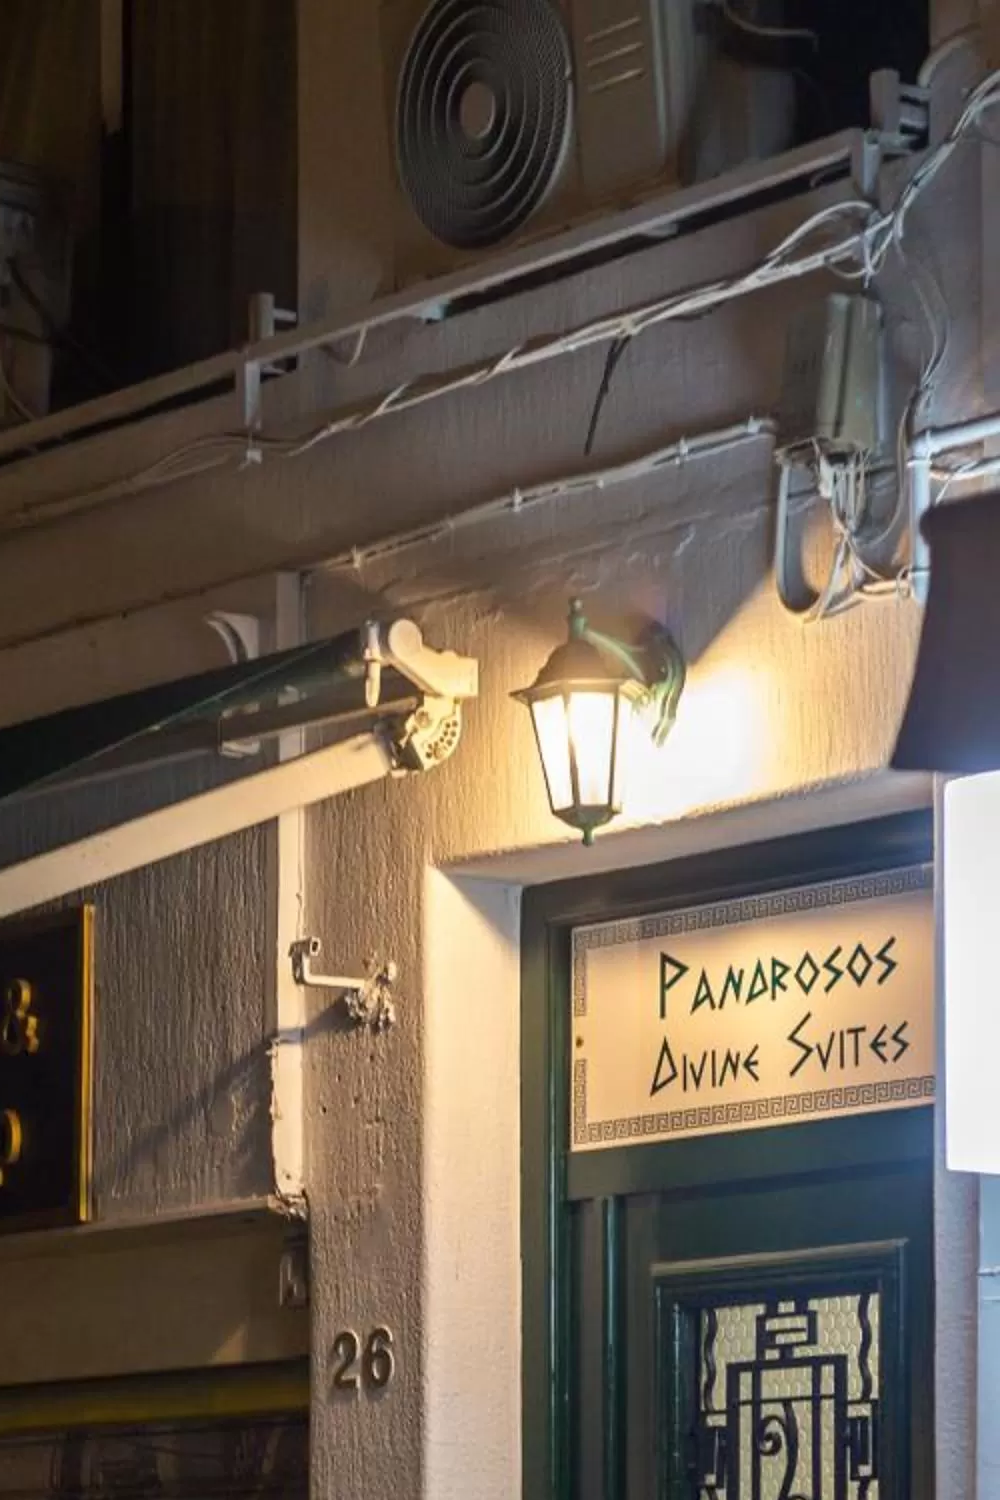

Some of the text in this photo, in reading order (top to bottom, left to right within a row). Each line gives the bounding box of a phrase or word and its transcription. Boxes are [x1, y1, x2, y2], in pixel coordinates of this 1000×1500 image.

[659, 936, 898, 1019] PANDROSOS
[2, 976, 41, 1056] &
[649, 1035, 760, 1097] DIVINE
[332, 1324, 396, 1389] 26
